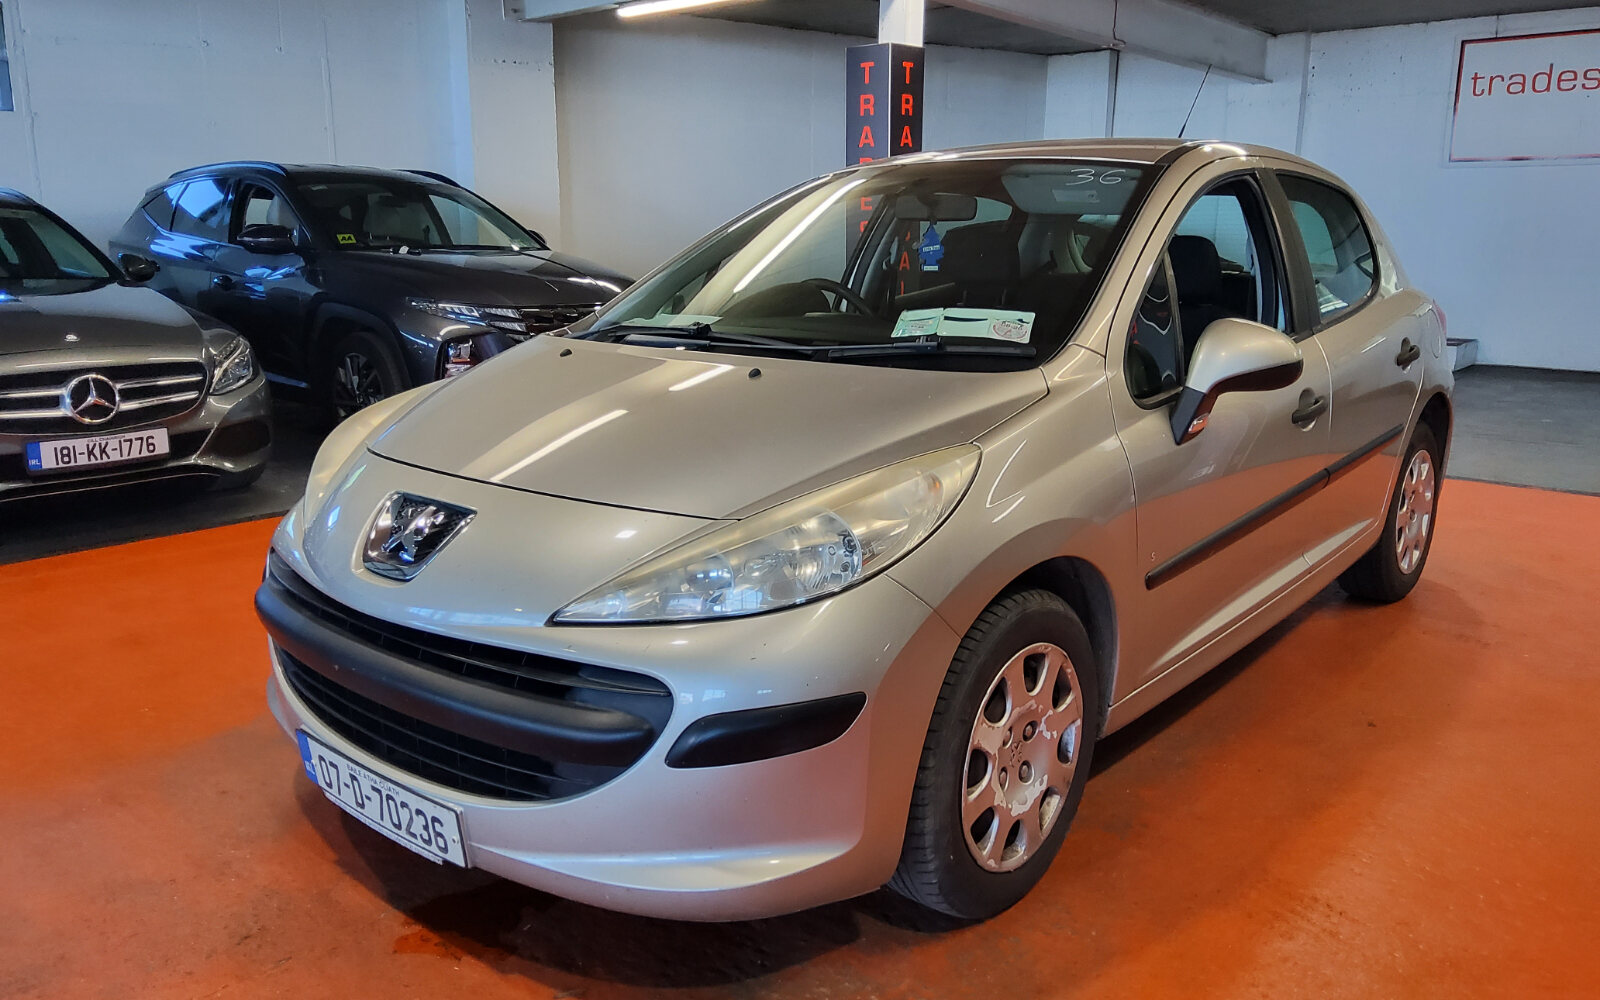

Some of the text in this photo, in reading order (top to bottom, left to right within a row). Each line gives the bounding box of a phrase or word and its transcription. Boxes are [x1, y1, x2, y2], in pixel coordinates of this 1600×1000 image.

[1065, 167, 1126, 186] 36
[54, 435, 156, 466] 181-KK-1776
[318, 754, 449, 855] 07-D-70236
